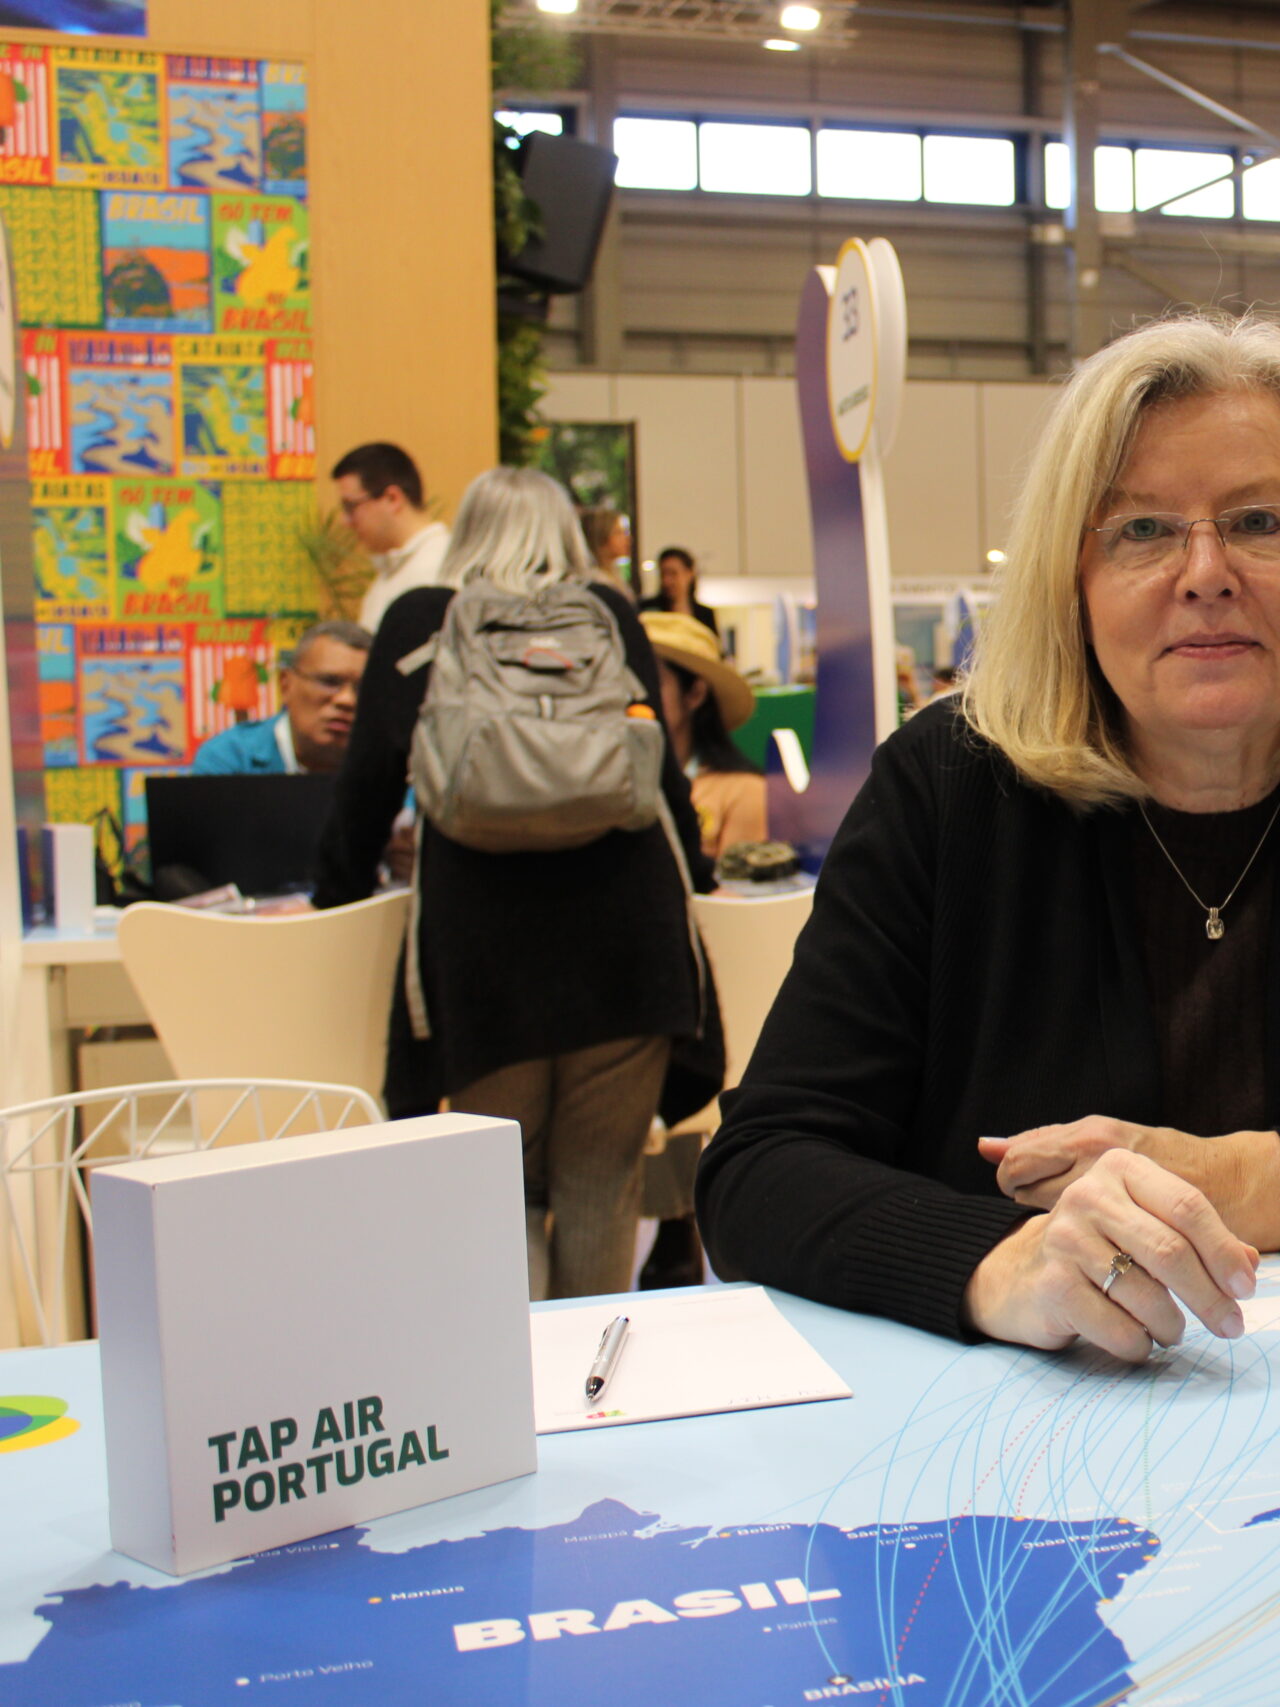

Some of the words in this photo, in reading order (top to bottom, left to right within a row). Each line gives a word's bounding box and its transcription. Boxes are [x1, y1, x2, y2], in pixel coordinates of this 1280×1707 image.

[106, 194, 204, 223] BRASIL
[221, 306, 311, 333] BRASIL
[122, 591, 214, 617] BRASIL
[208, 1417, 298, 1474] TAP
[312, 1395, 386, 1450] AIR
[212, 1424, 450, 1524] PORTUGAL
[737, 1523, 791, 1536] Belém
[391, 1586, 464, 1601] Manaus
[453, 1577, 842, 1652] BRASIL
[259, 1666, 314, 1683] Porto
[318, 1659, 374, 1676] Velho
